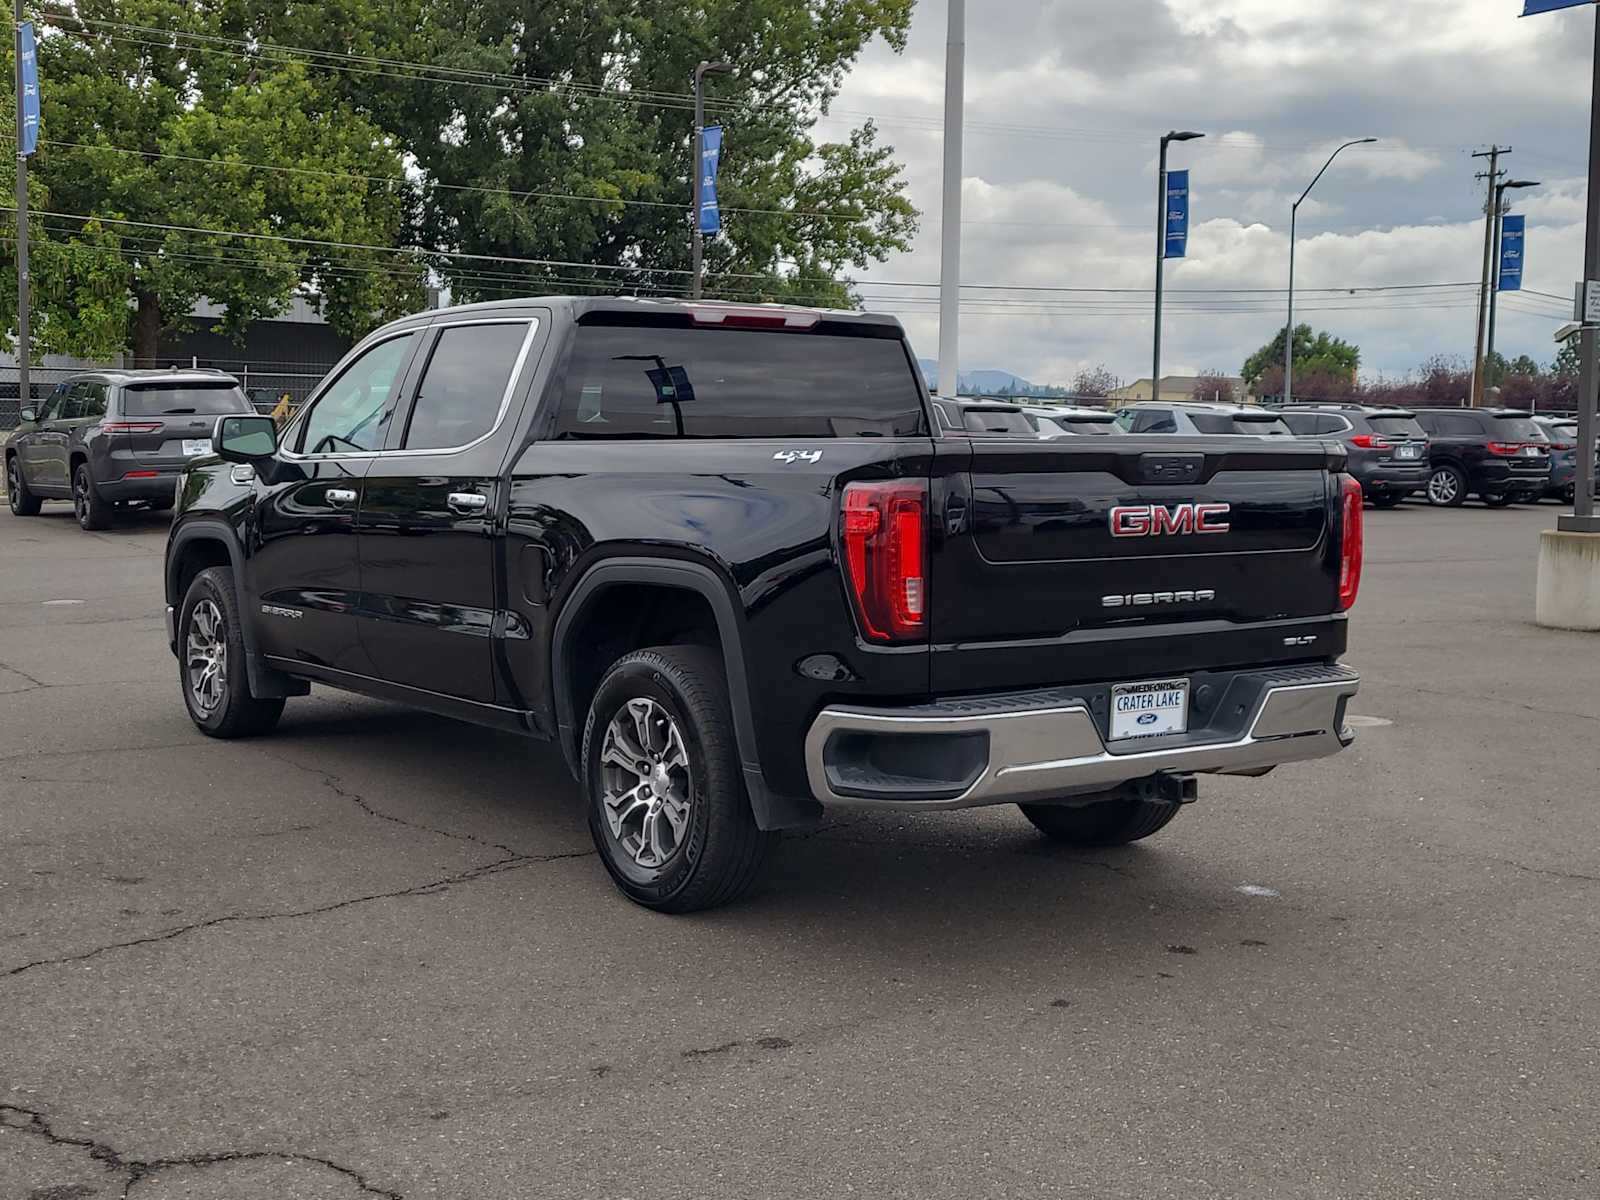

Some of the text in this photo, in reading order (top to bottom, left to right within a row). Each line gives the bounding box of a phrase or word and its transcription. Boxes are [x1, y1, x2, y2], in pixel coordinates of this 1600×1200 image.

[1110, 503, 1230, 537] GMC
[1102, 589, 1215, 607] SIERRA
[1284, 635, 1317, 647] SLT
[1132, 682, 1173, 693] MEDFORD
[1117, 691, 1181, 711] CRATER LAKE
